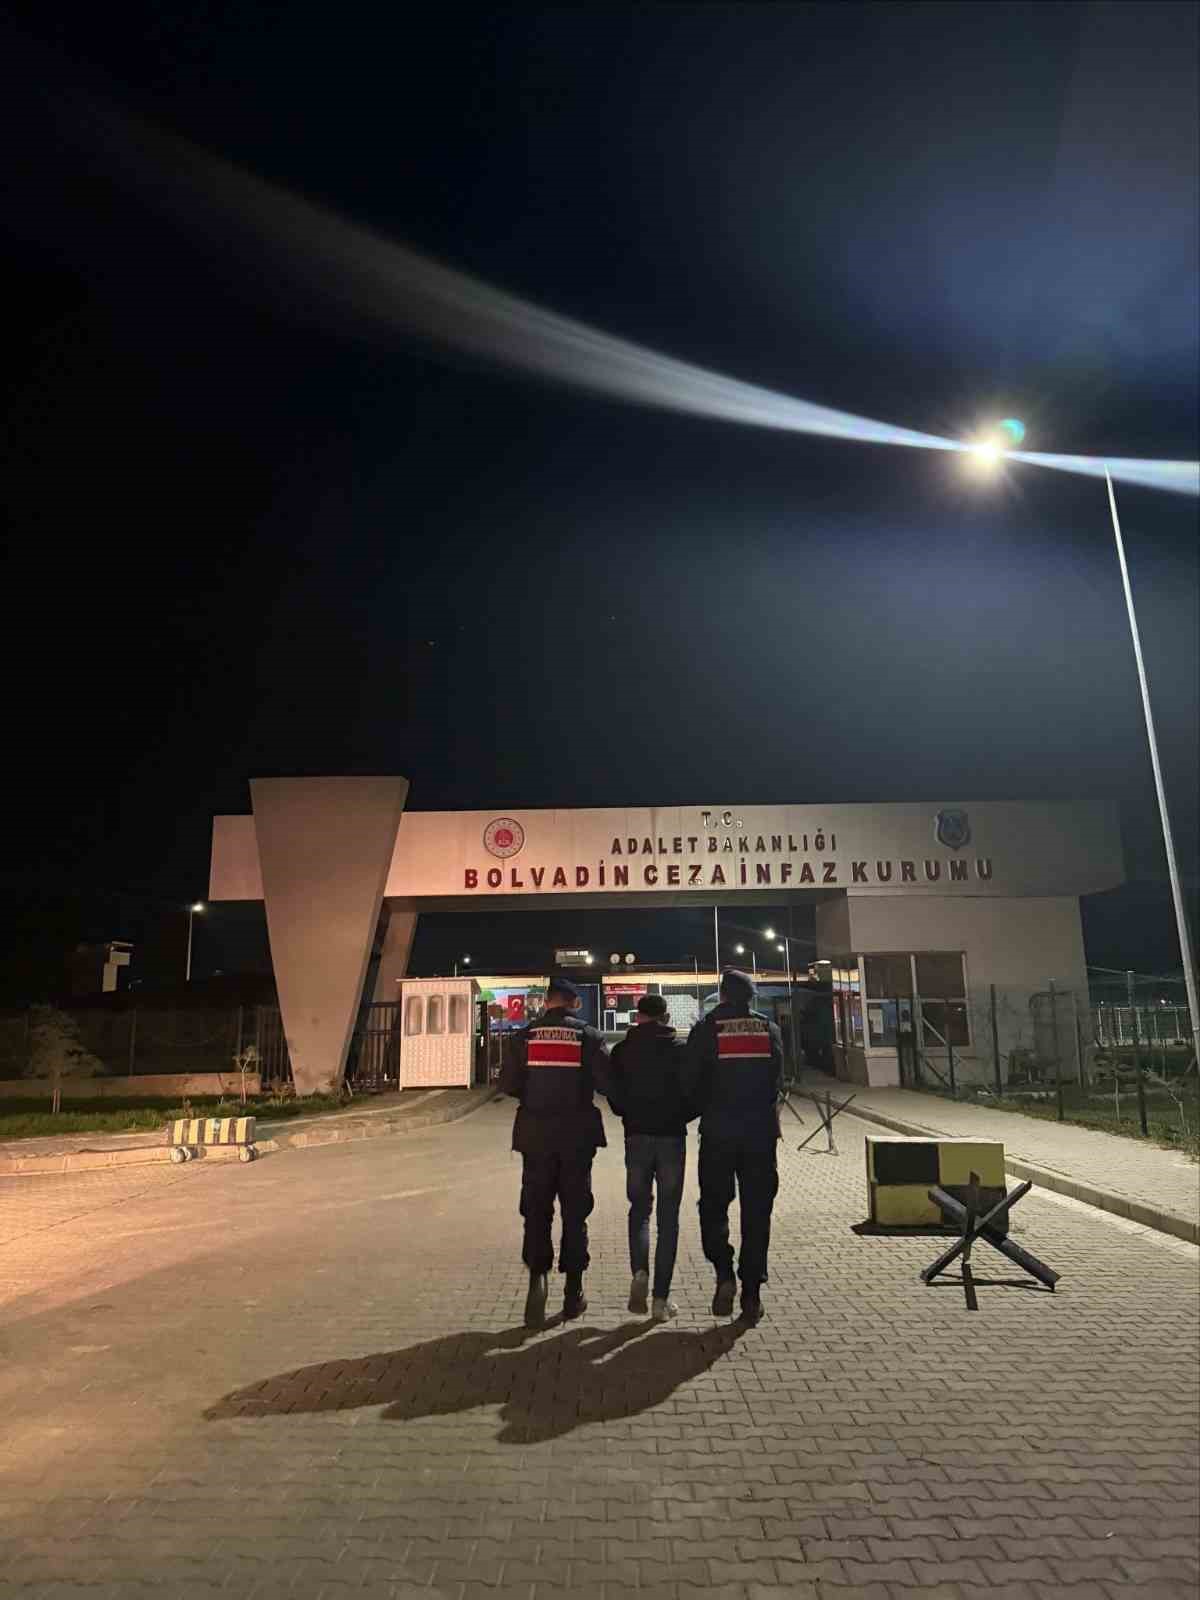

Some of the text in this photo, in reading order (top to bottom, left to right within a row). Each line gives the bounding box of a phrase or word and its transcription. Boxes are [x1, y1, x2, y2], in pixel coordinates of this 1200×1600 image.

[701, 811, 743, 827] T.C.
[611, 827, 836, 855] ADALET BAKANLIĞI
[464, 857, 993, 889] BOLVADİN CEZA İNFAZ KURUMU
